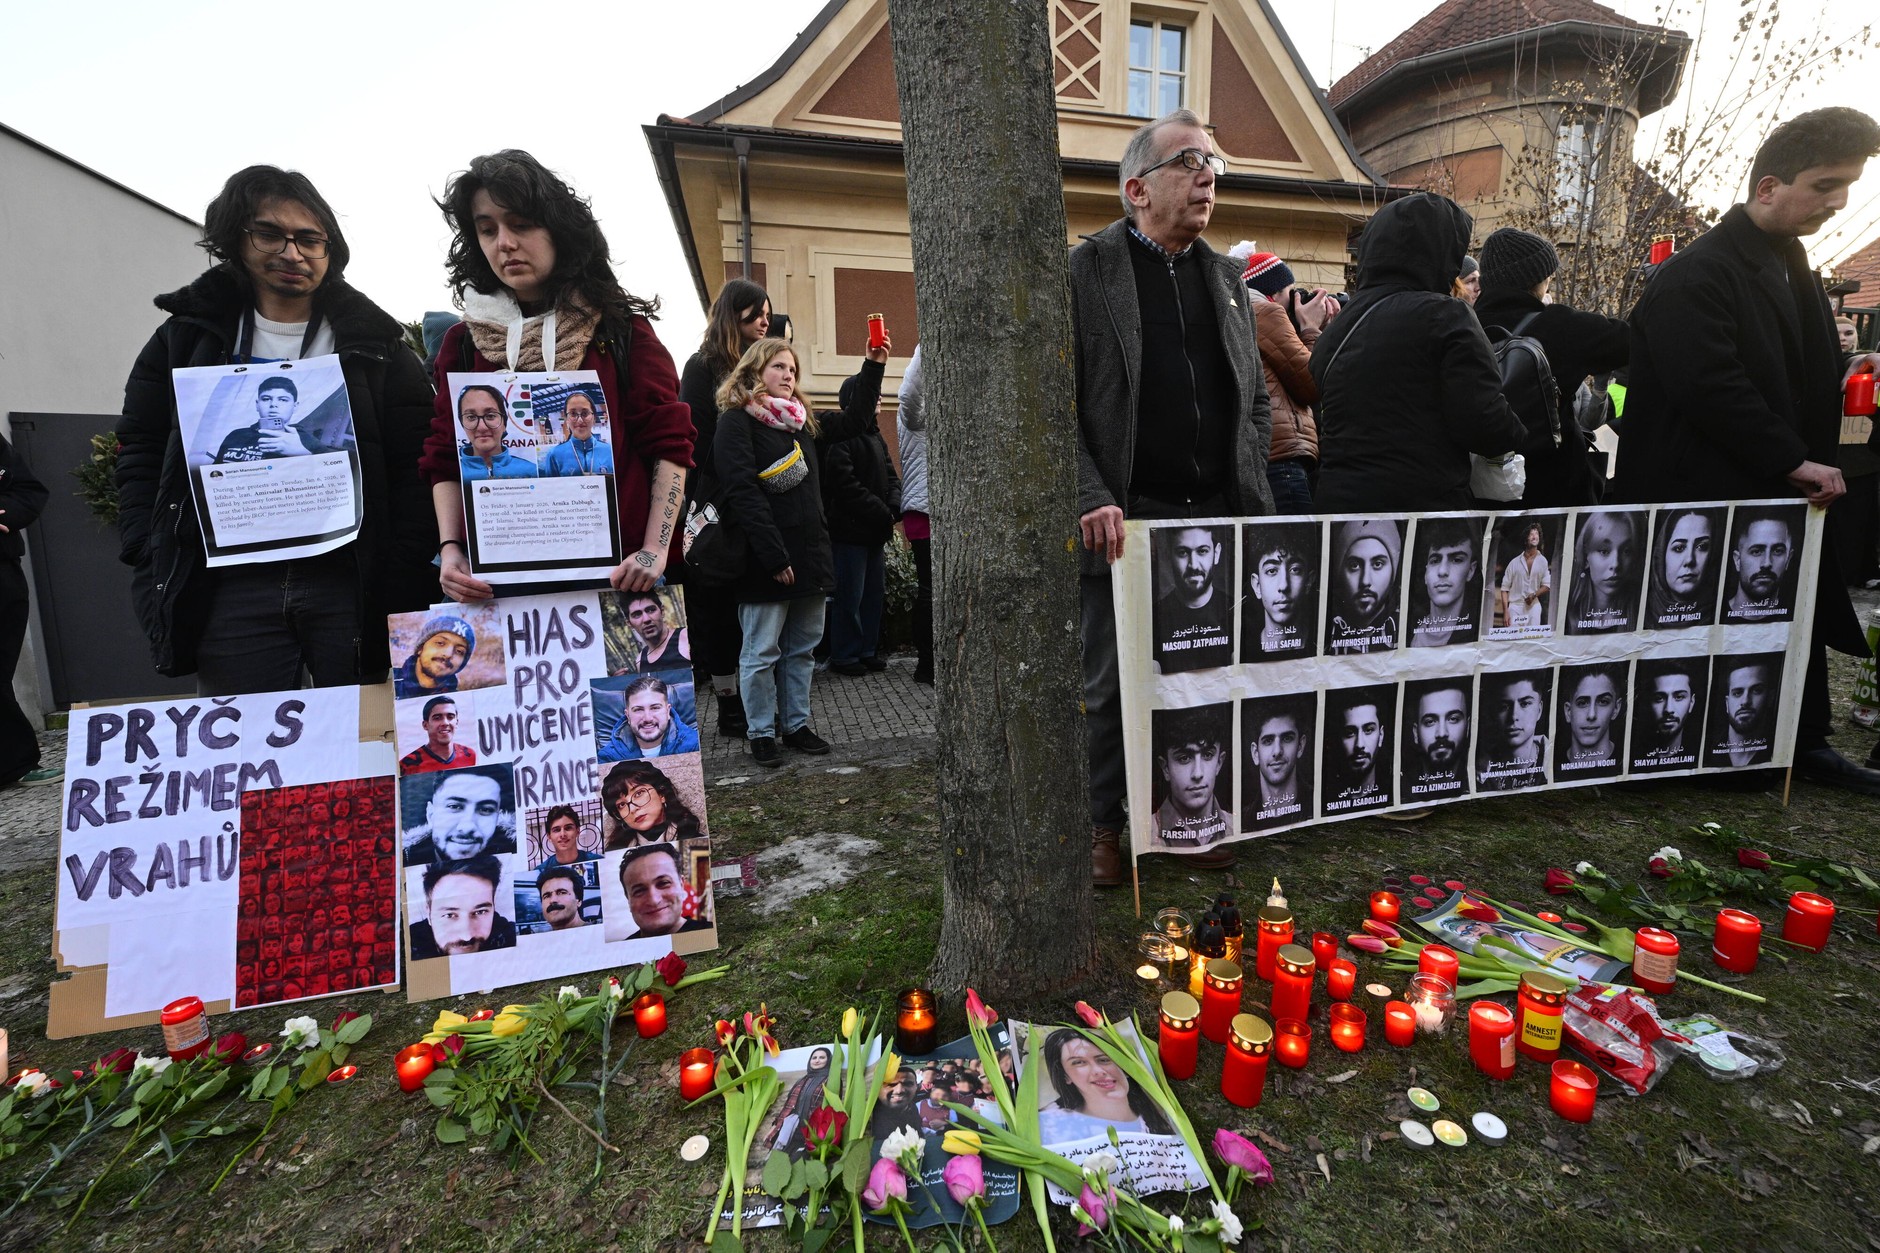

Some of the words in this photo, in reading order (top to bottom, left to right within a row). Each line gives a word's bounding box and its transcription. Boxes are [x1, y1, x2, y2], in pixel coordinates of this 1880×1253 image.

[1578, 619, 1602, 628] ROBINA
[1658, 615, 1679, 623] AKRAM
[1199, 625, 1221, 635] مسعود
[1162, 639, 1191, 652] MASOUD
[1261, 640, 1278, 650] TAHA
[1280, 638, 1302, 648] SAFARI
[1332, 637, 1370, 648] AMIRHOSEIN
[1372, 635, 1392, 644] BAYATI
[514, 658, 580, 708] PRO
[476, 690, 592, 757] UMIČENÉ
[86, 697, 242, 767] PRYČ
[266, 700, 306, 748] S
[1561, 760, 1596, 771] MOHAMMAD
[1597, 759, 1616, 767] NOORI
[1634, 757, 1658, 767] SHAYAN
[1659, 755, 1695, 765] ASADOLLAHI
[512, 750, 600, 808] ÍRÁNCE
[1445, 770, 1455, 779] رضا
[1411, 785, 1428, 794] REZA
[1429, 781, 1461, 792] AZIMZADEH
[66, 759, 284, 831] REŽIMEM
[1257, 809, 1276, 820] ERFAN
[1277, 803, 1301, 816] BOZORGI
[1327, 800, 1351, 811] SHAYAN
[1162, 830, 1196, 839] FARSHID
[65, 821, 238, 902] VRAHŮ
[1525, 1030, 1556, 1040] INTERNATIONAL
[1526, 1022, 1557, 1036] AMNESTY
[1069, 1149, 1082, 1159] مادر
